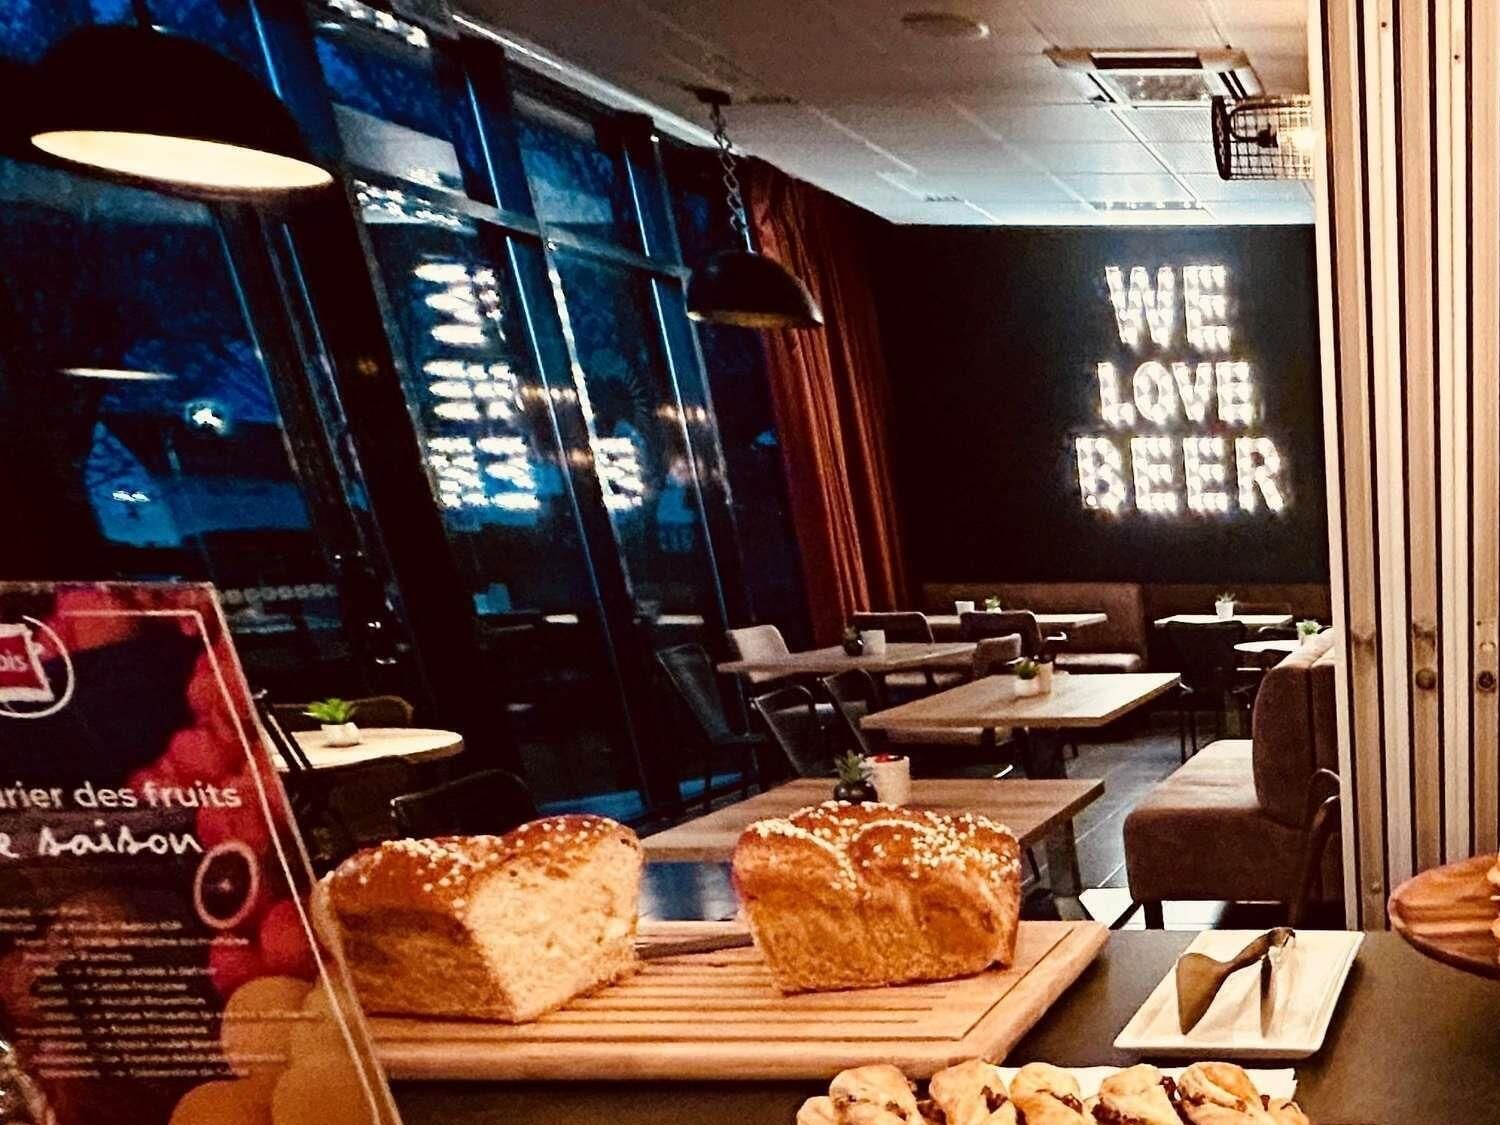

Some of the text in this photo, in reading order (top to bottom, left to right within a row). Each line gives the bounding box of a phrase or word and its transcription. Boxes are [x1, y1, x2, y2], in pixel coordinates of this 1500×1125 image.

[1105, 265, 1230, 349] WE
[1097, 361, 1254, 427] LOVE
[1076, 437, 1284, 515] BEER
[73, 781, 138, 808] des
[143, 780, 242, 808] fruits
[38, 819, 203, 856] saison
